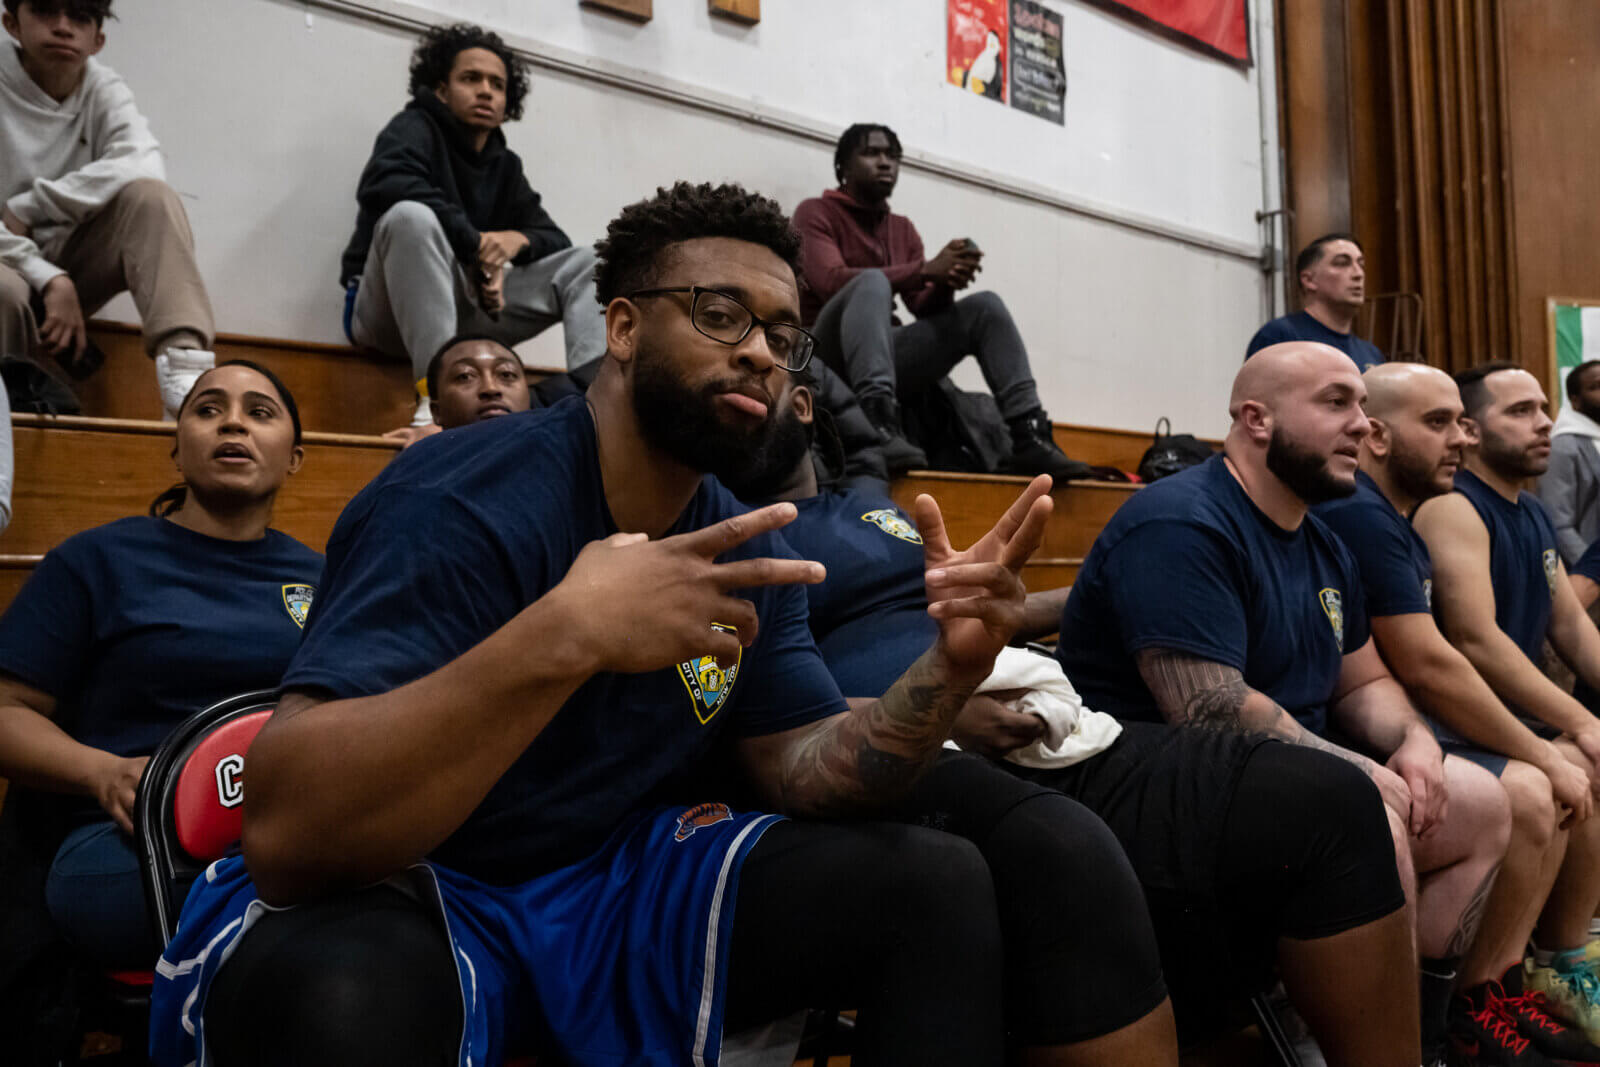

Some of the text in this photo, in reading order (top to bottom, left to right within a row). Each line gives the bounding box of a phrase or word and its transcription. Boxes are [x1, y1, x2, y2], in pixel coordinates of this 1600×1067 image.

[682, 662, 698, 685] CITY
[717, 663, 738, 705] NEW YOR
